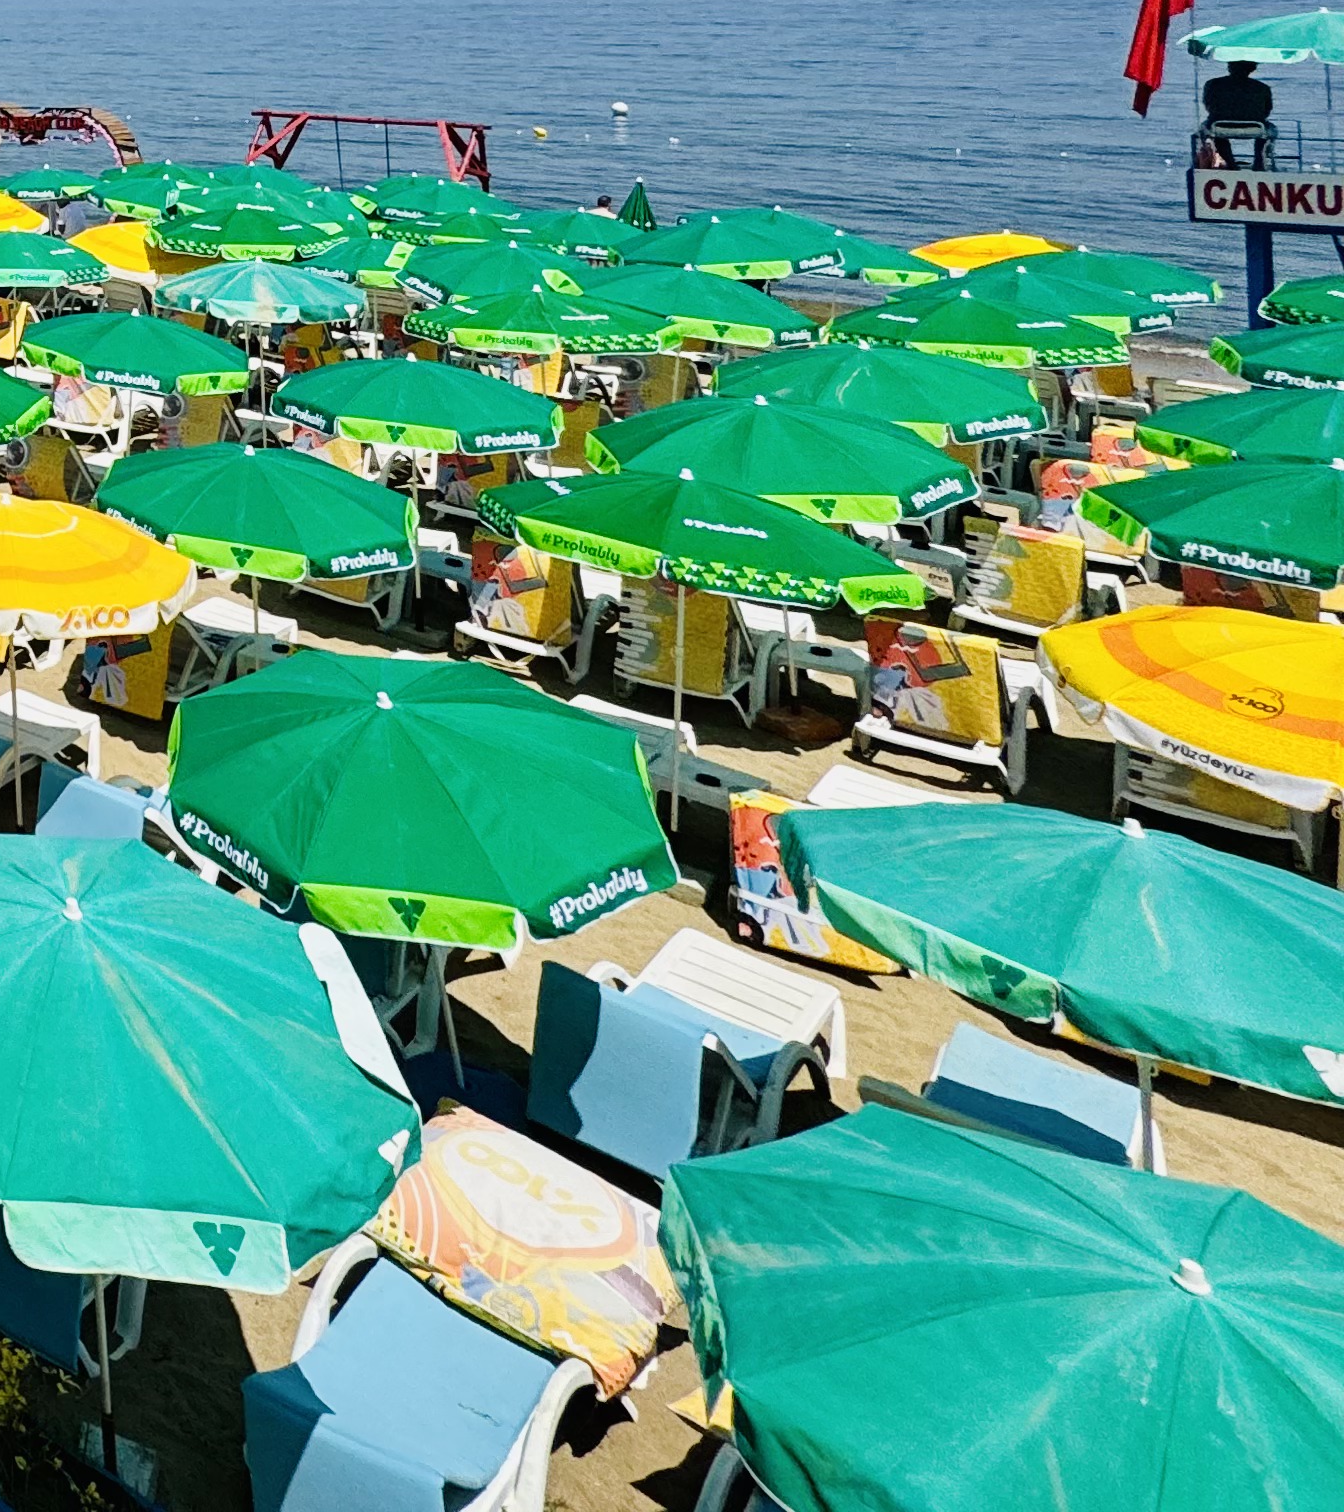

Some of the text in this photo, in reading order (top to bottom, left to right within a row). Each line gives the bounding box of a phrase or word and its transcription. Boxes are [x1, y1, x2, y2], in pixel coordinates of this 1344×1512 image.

[1203, 179, 1344, 216] CANKU
[96, 369, 160, 389] #Probably
[475, 431, 541, 448] #Probably
[966, 415, 1031, 435] #Probably
[331, 549, 398, 572] #Probably
[541, 534, 620, 566] #Probably
[1180, 541, 1311, 584] #Probably
[1162, 739, 1255, 781] #yüzdeyüz
[180, 811, 269, 890] #Probably
[548, 866, 648, 929] #Probably
